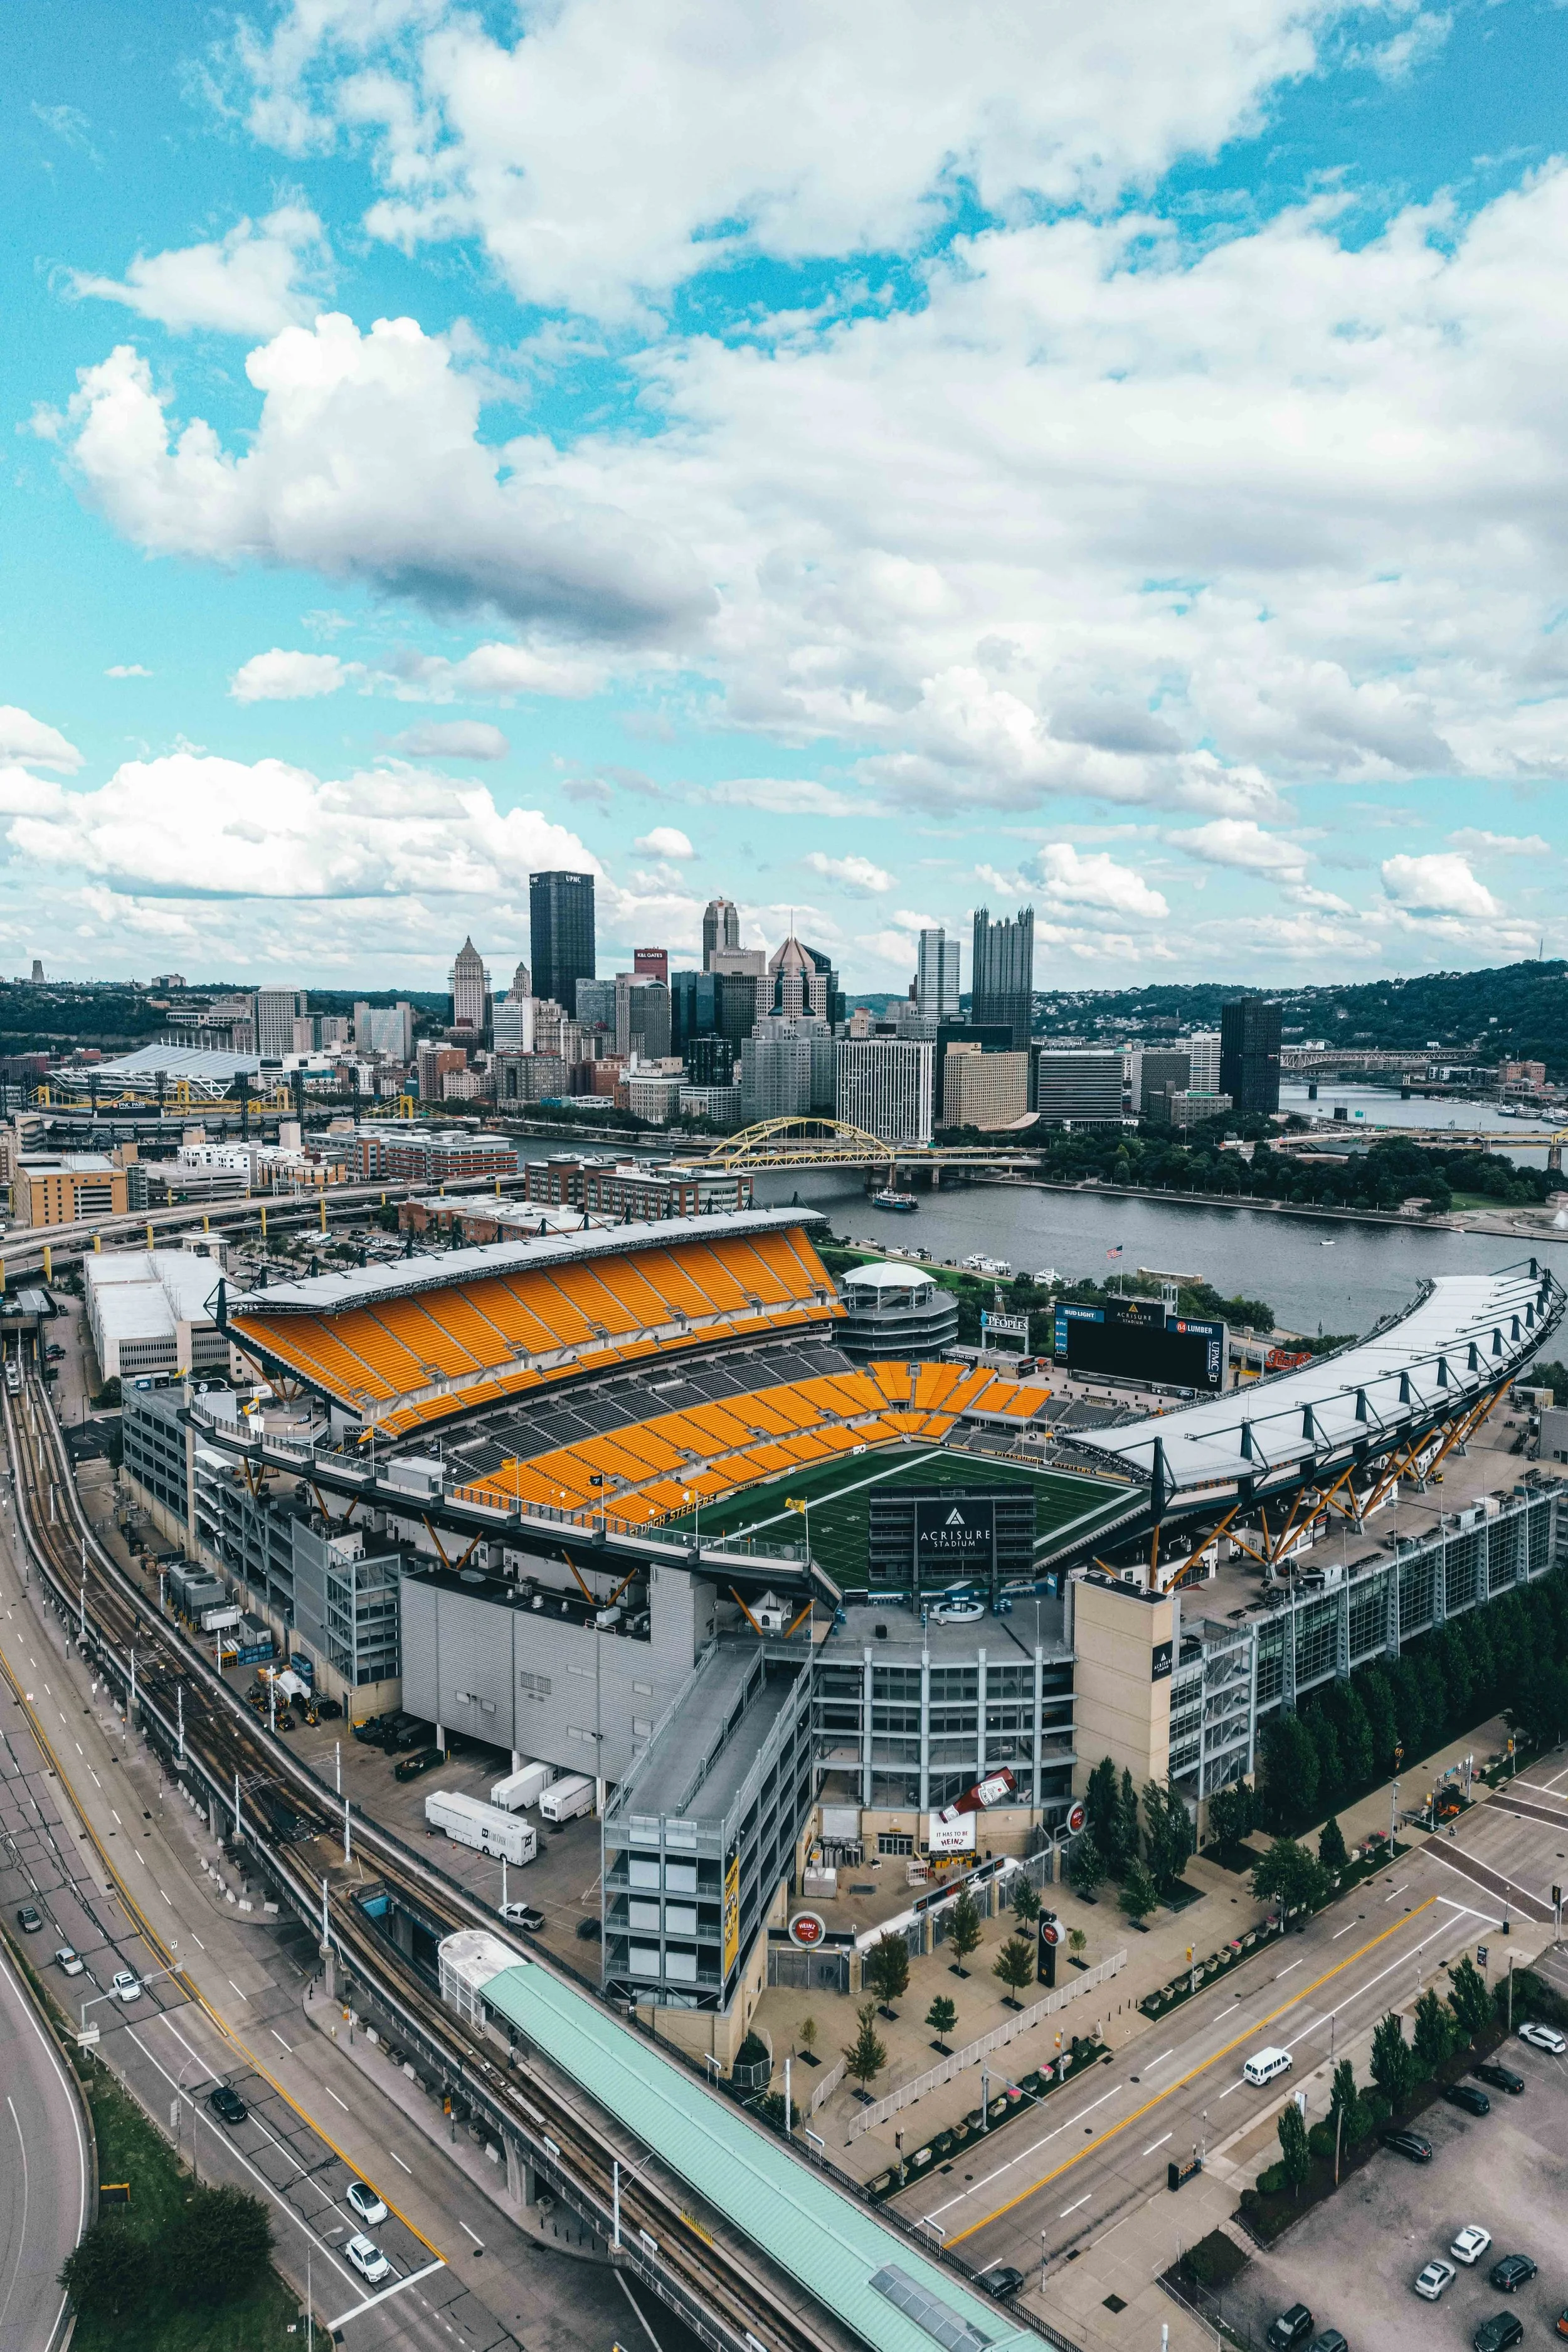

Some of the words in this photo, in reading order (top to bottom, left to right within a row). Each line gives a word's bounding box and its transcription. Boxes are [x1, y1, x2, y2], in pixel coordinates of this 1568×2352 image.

[1117, 1312, 1152, 1321] ACRISURE
[988, 1317, 1028, 1331] PEOPLES
[1177, 1323, 1186, 1332] 84
[1187, 1325, 1212, 1335] LUMBER
[1211, 1342, 1219, 1371] UPMC
[995, 1451, 1041, 1464] PITTSBURGH
[1054, 1462, 1091, 1474] STEELERS
[669, 1494, 715, 1522] STEELERS
[920, 1530, 990, 1541] ACRISURE
[941, 1838, 964, 1846] HEINZ
